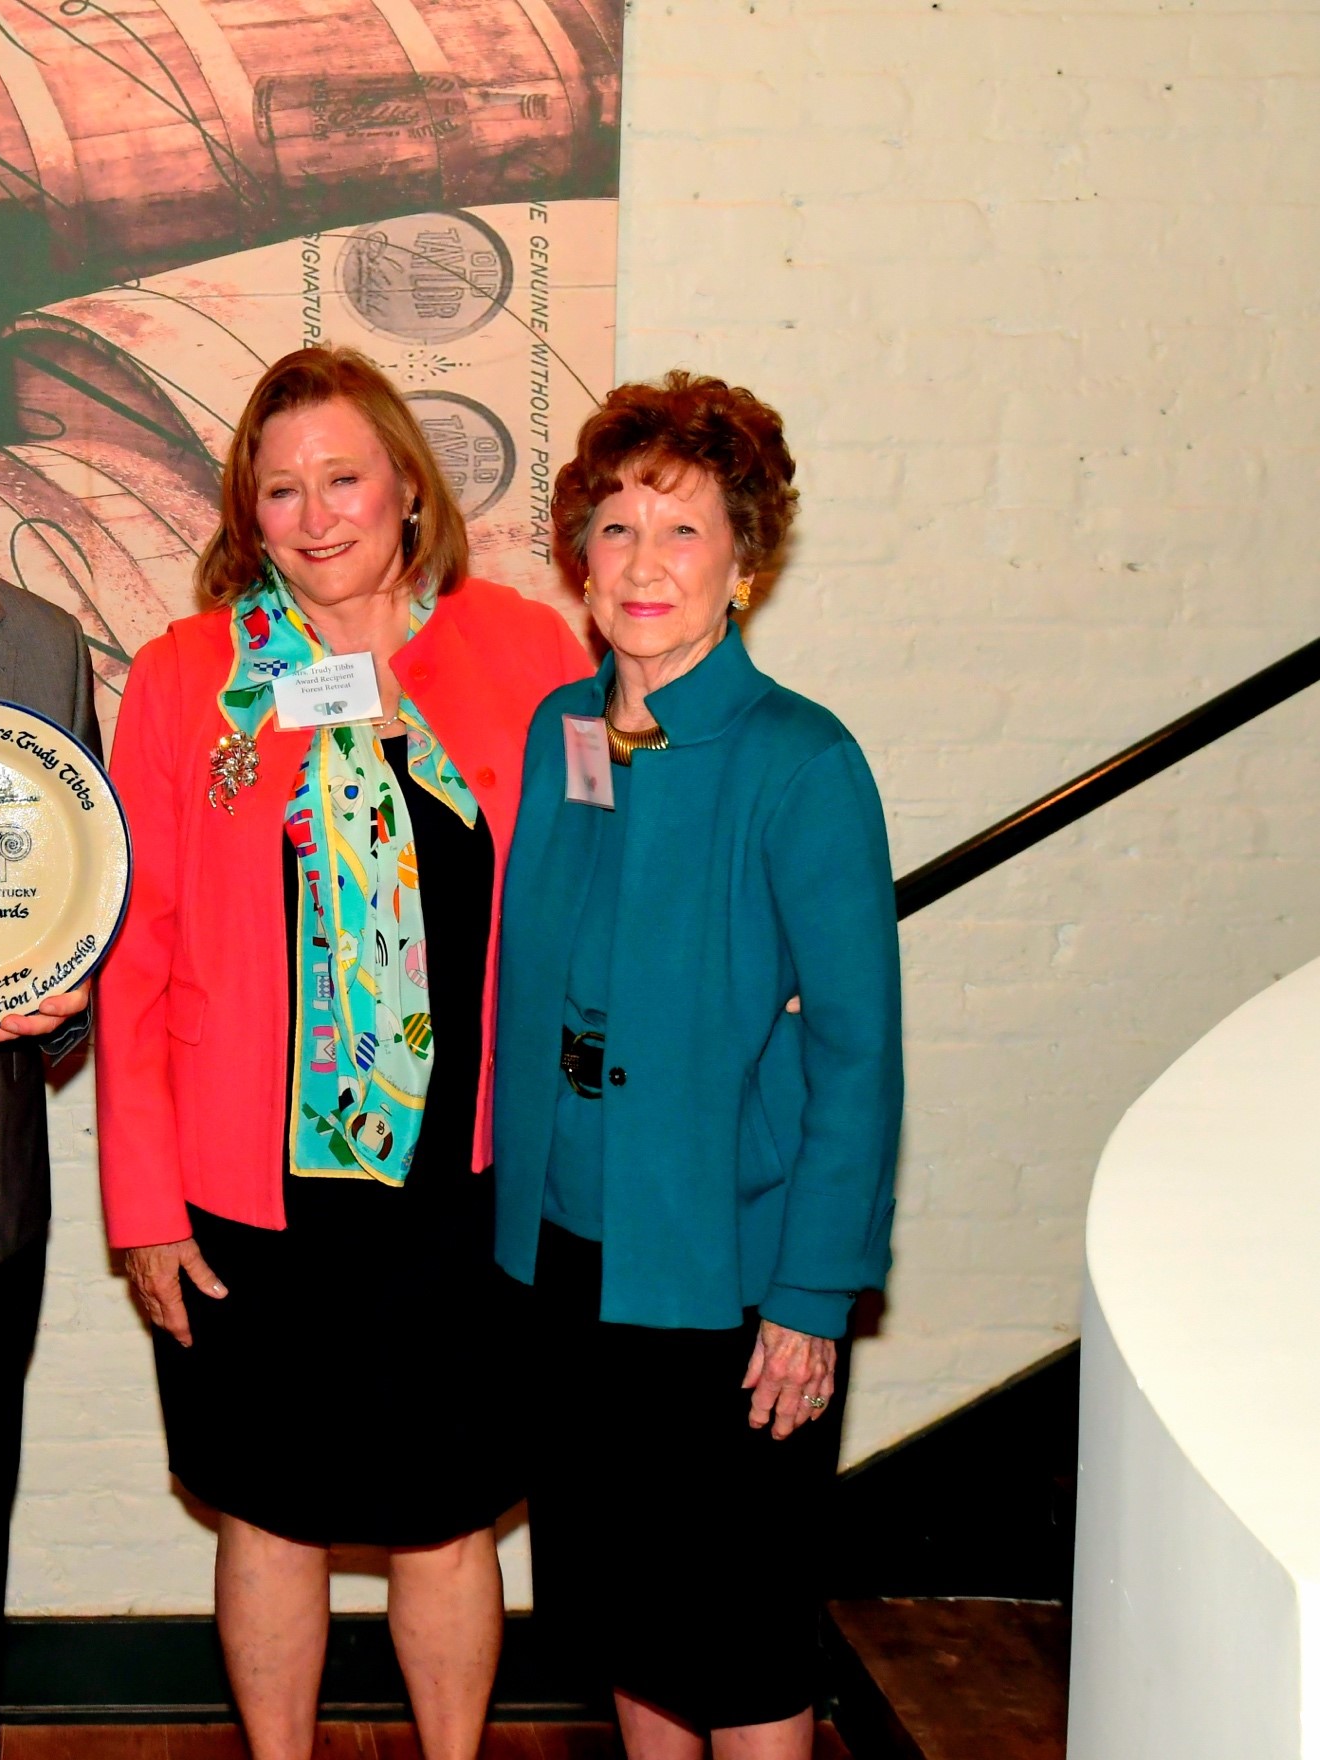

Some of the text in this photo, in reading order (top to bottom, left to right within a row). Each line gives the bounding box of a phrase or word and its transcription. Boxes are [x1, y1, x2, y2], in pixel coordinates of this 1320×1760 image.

[410, 226, 468, 319] TAYLOR
[469, 250, 499, 298] OLD
[530, 235, 549, 333] GENUINE
[530, 342, 551, 443] WITHOUT
[473, 435, 499, 484] OLD
[530, 447, 552, 565] PORTRAIT
[295, 673, 354, 686] Award Recipient
[301, 682, 351, 694] Forest Retreat
[334, 663, 355, 672] Tibbs
[16, 731, 61, 770] Trudy
[59, 763, 95, 812] Tibbs
[30, 933, 97, 1000] Leadership
